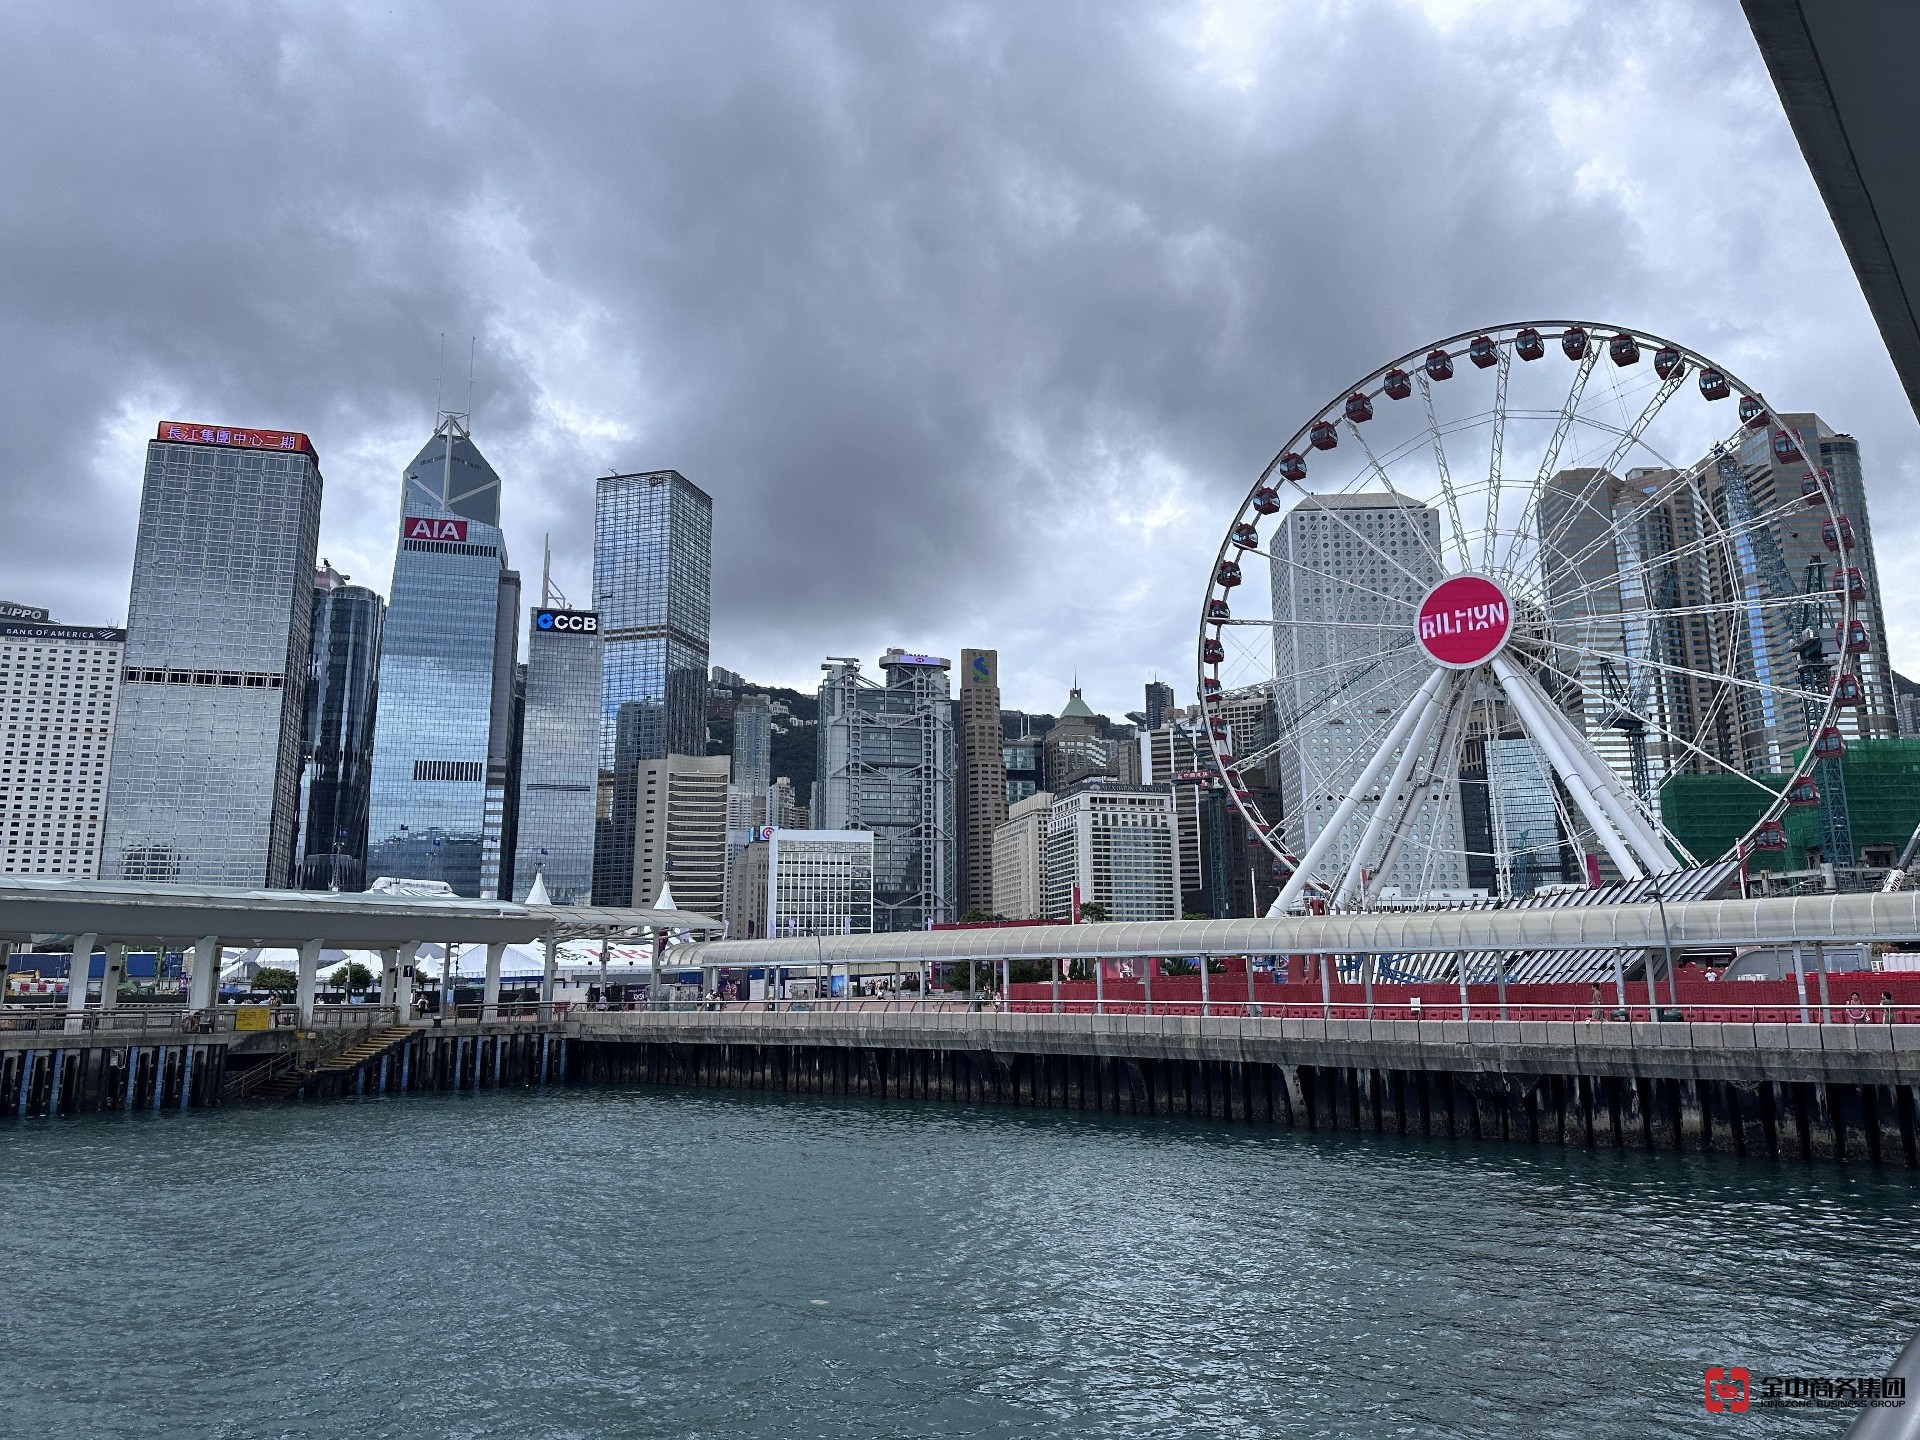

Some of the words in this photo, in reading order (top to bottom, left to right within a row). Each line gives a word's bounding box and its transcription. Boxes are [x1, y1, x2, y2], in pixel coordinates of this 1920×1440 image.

[167, 425, 296, 450] 長江集團中心二期
[411, 519, 460, 540] AIA
[0, 606, 42, 620] LIPPO
[554, 614, 597, 631] CCB
[6, 628, 33, 636] BANK
[50, 630, 95, 639] AMERICA
